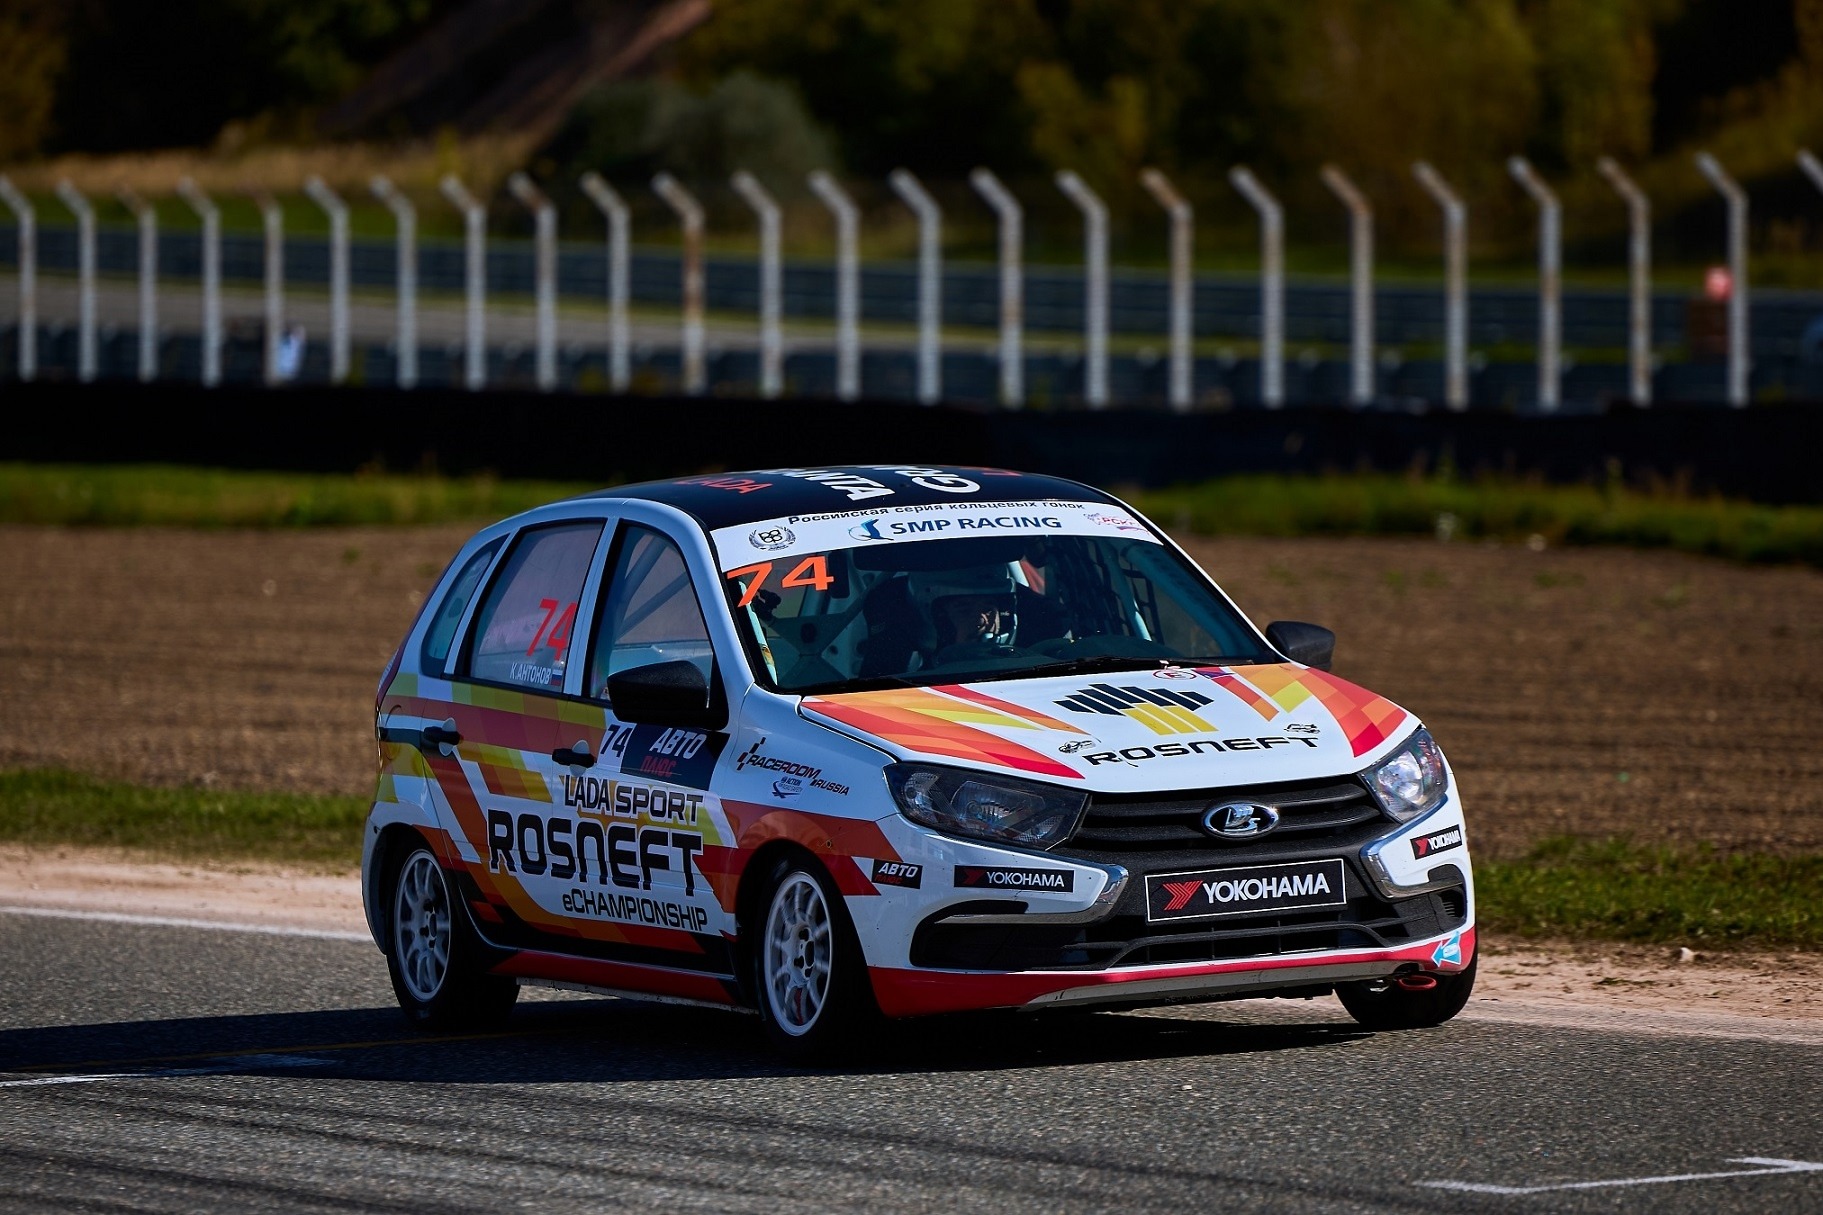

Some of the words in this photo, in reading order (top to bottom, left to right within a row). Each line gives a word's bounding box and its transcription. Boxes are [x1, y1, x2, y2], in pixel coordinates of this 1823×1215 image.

[890, 518, 951, 535] SMP
[957, 516, 1063, 531] RACING
[727, 554, 835, 608] 74
[526, 598, 577, 662] 74
[600, 723, 633, 758] 74
[649, 727, 708, 760] АВТО
[1082, 736, 1319, 766] ROSNEFT
[746, 754, 822, 780] RACEROOM
[564, 774, 612, 812] LADA
[616, 785, 704, 823] SPORT
[814, 779, 850, 796] RUSSIA
[487, 808, 703, 897] ROSNEFT
[1428, 829, 1461, 850] YOKOHAMA
[986, 871, 1065, 888] YOKOHAMA
[1203, 872, 1331, 904] YOKOHAMA
[562, 888, 708, 932] eCHAMPIONSHIP
